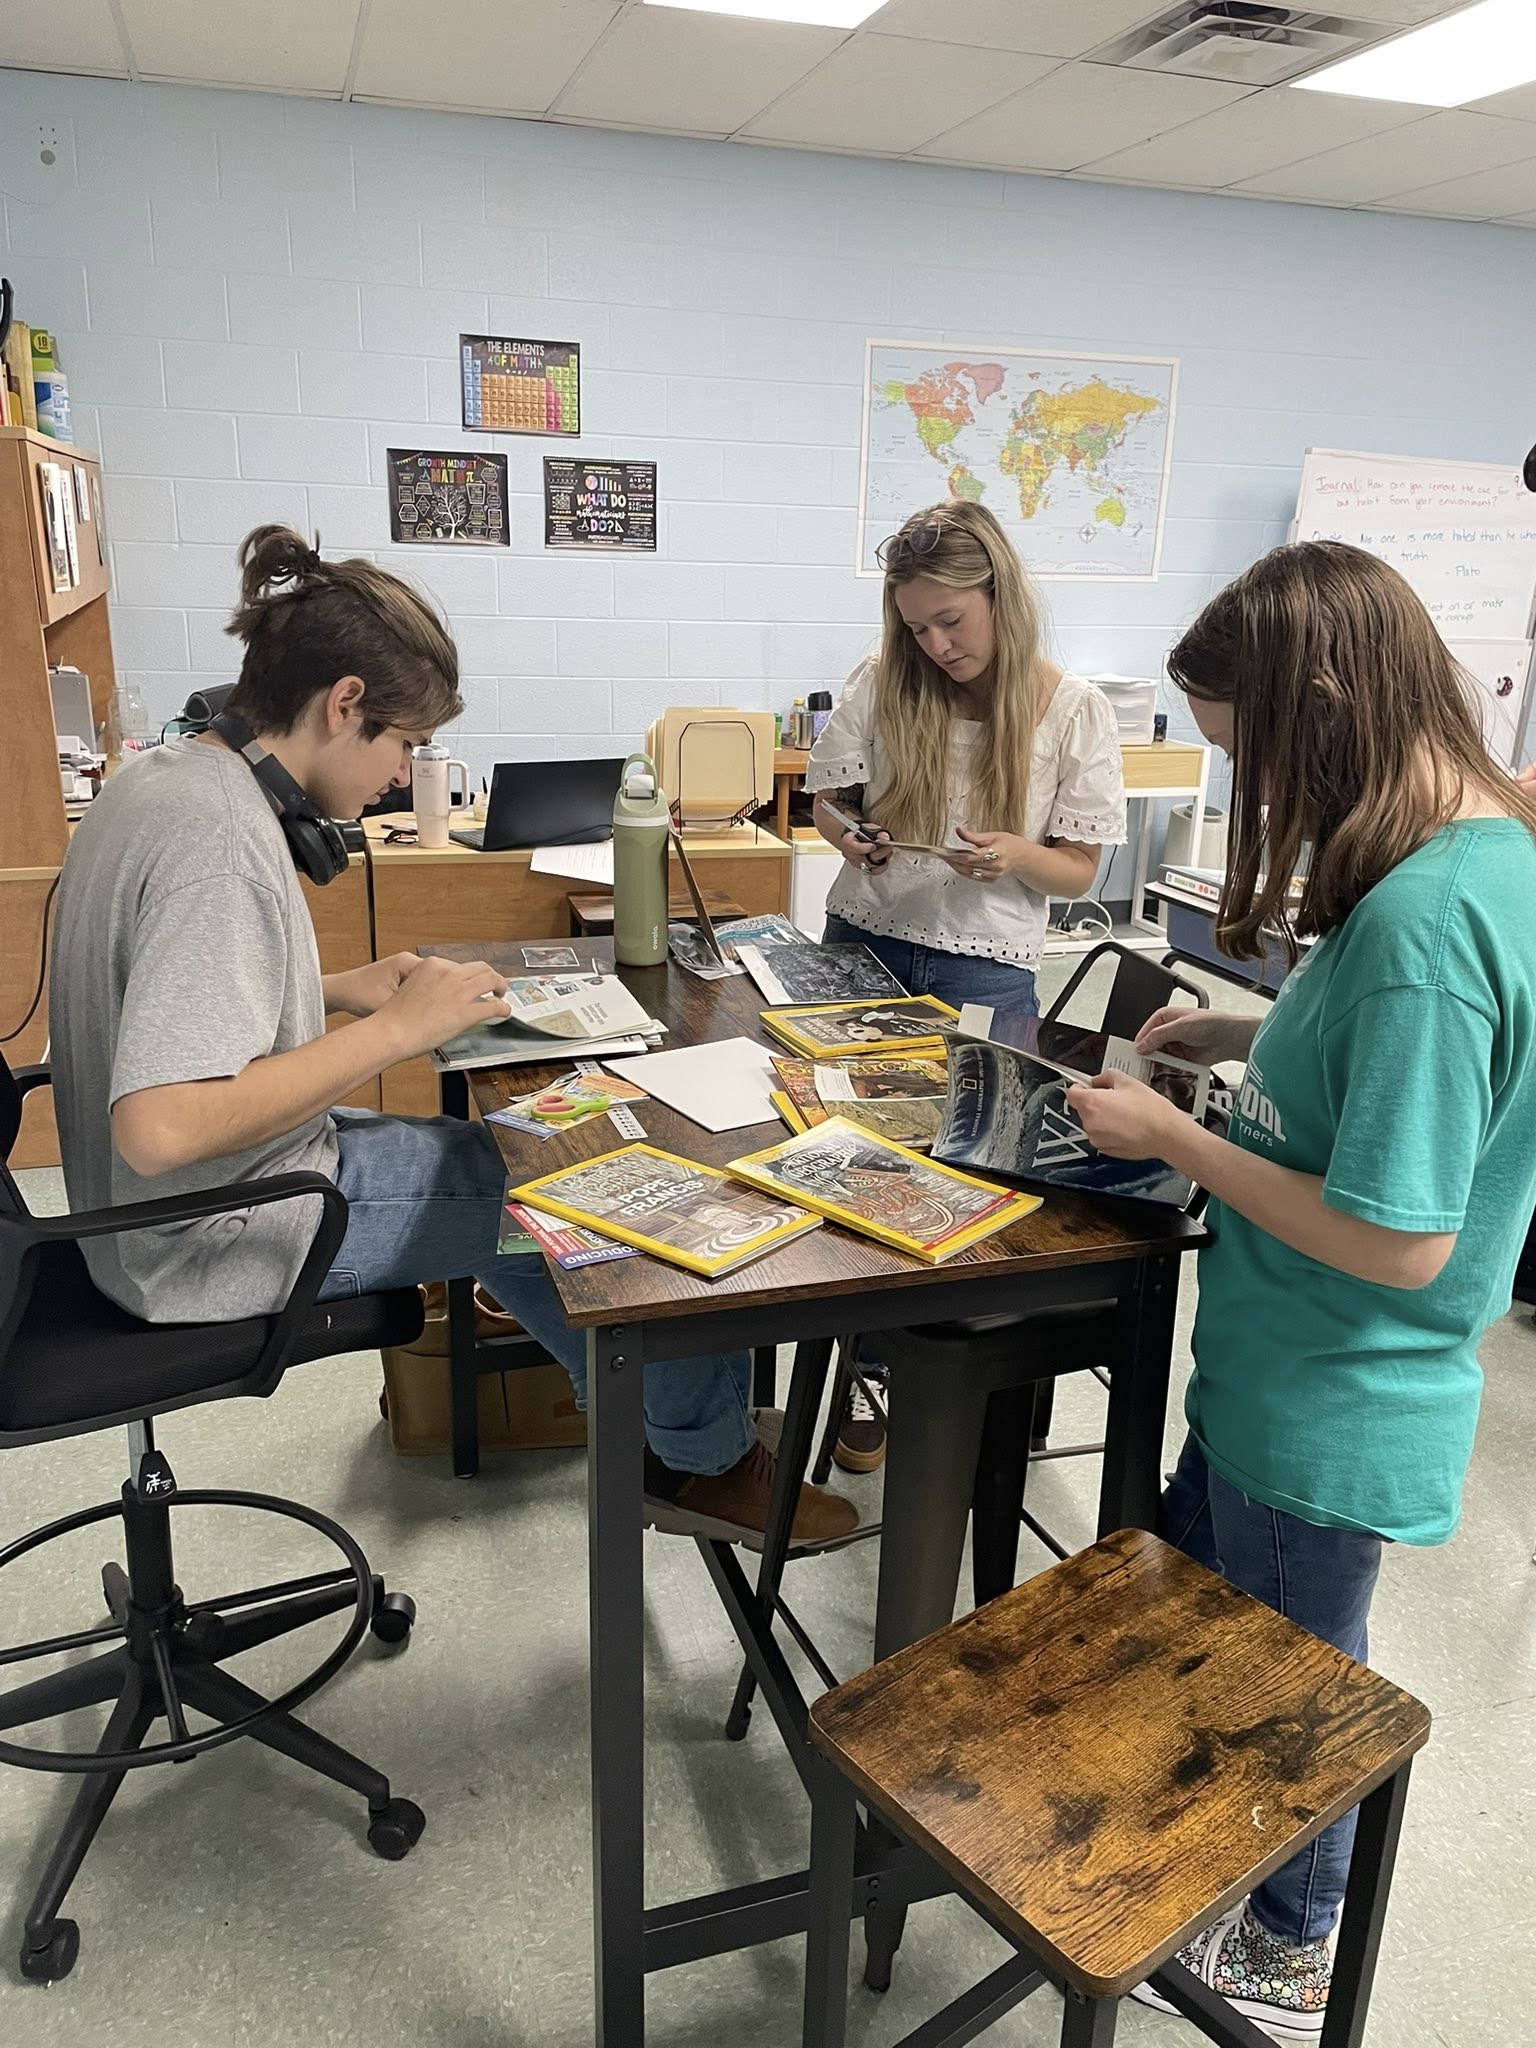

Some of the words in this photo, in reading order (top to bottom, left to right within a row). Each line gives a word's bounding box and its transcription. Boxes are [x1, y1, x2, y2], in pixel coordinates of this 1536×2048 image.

[486, 341, 502, 353] THE
[503, 342, 545, 356] ELEMENTS
[494, 354, 507, 366] OF
[510, 355, 537, 369] MATH
[1462, 482, 1474, 493] the
[576, 493, 608, 507] WHAT
[610, 494, 627, 508] DO
[590, 519, 614, 533] DO?
[1360, 532, 1373, 544] No
[1381, 533, 1397, 543] one
[1407, 533, 1416, 542] is
[1423, 532, 1444, 541] more
[1452, 528, 1476, 541] hated
[1480, 529, 1502, 541] than
[1400, 551, 1430, 562] truth
[1455, 564, 1481, 577] Plato
[788, 1143, 843, 1167] NATIONAL
[788, 1141, 864, 1178] GEOGRAPHIC
[617, 1178, 676, 1204] POPE
[619, 1180, 705, 1217] FRANCIS
[565, 1245, 638, 1265] ODUCING
